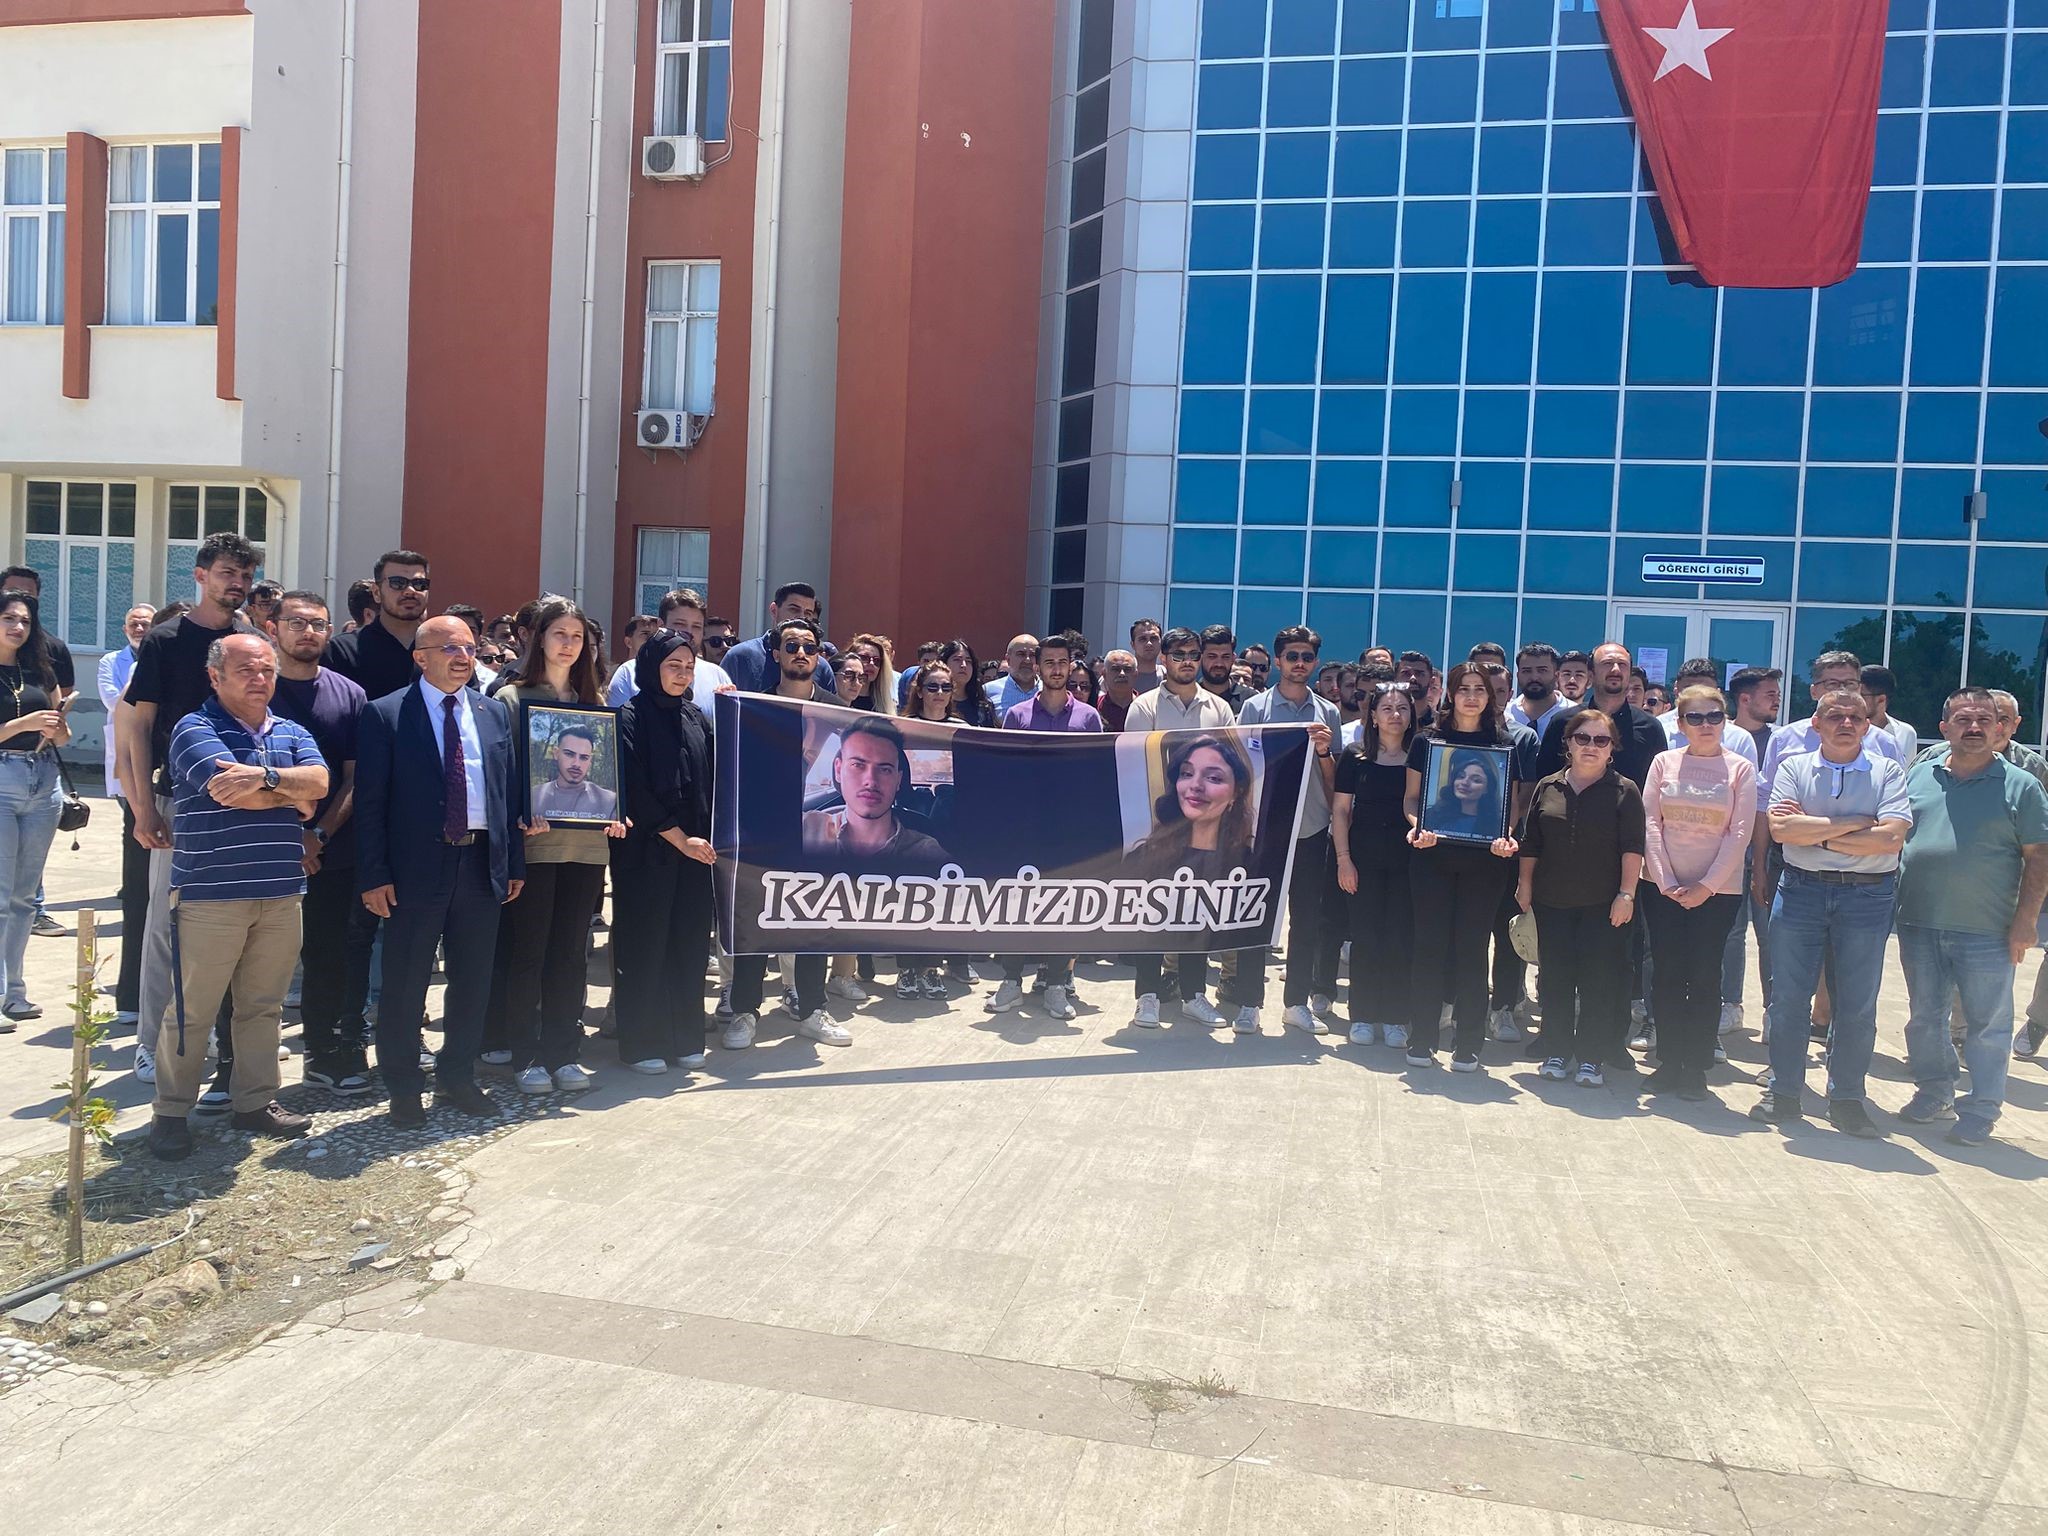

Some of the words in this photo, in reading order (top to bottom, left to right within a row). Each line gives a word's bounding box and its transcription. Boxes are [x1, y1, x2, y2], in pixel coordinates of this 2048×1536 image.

[1657, 563, 1710, 574] ÖĞRENCİ
[1714, 565, 1750, 576] GİRİŞİ
[760, 864, 1269, 932] KALBİMİZDESİNİZ
